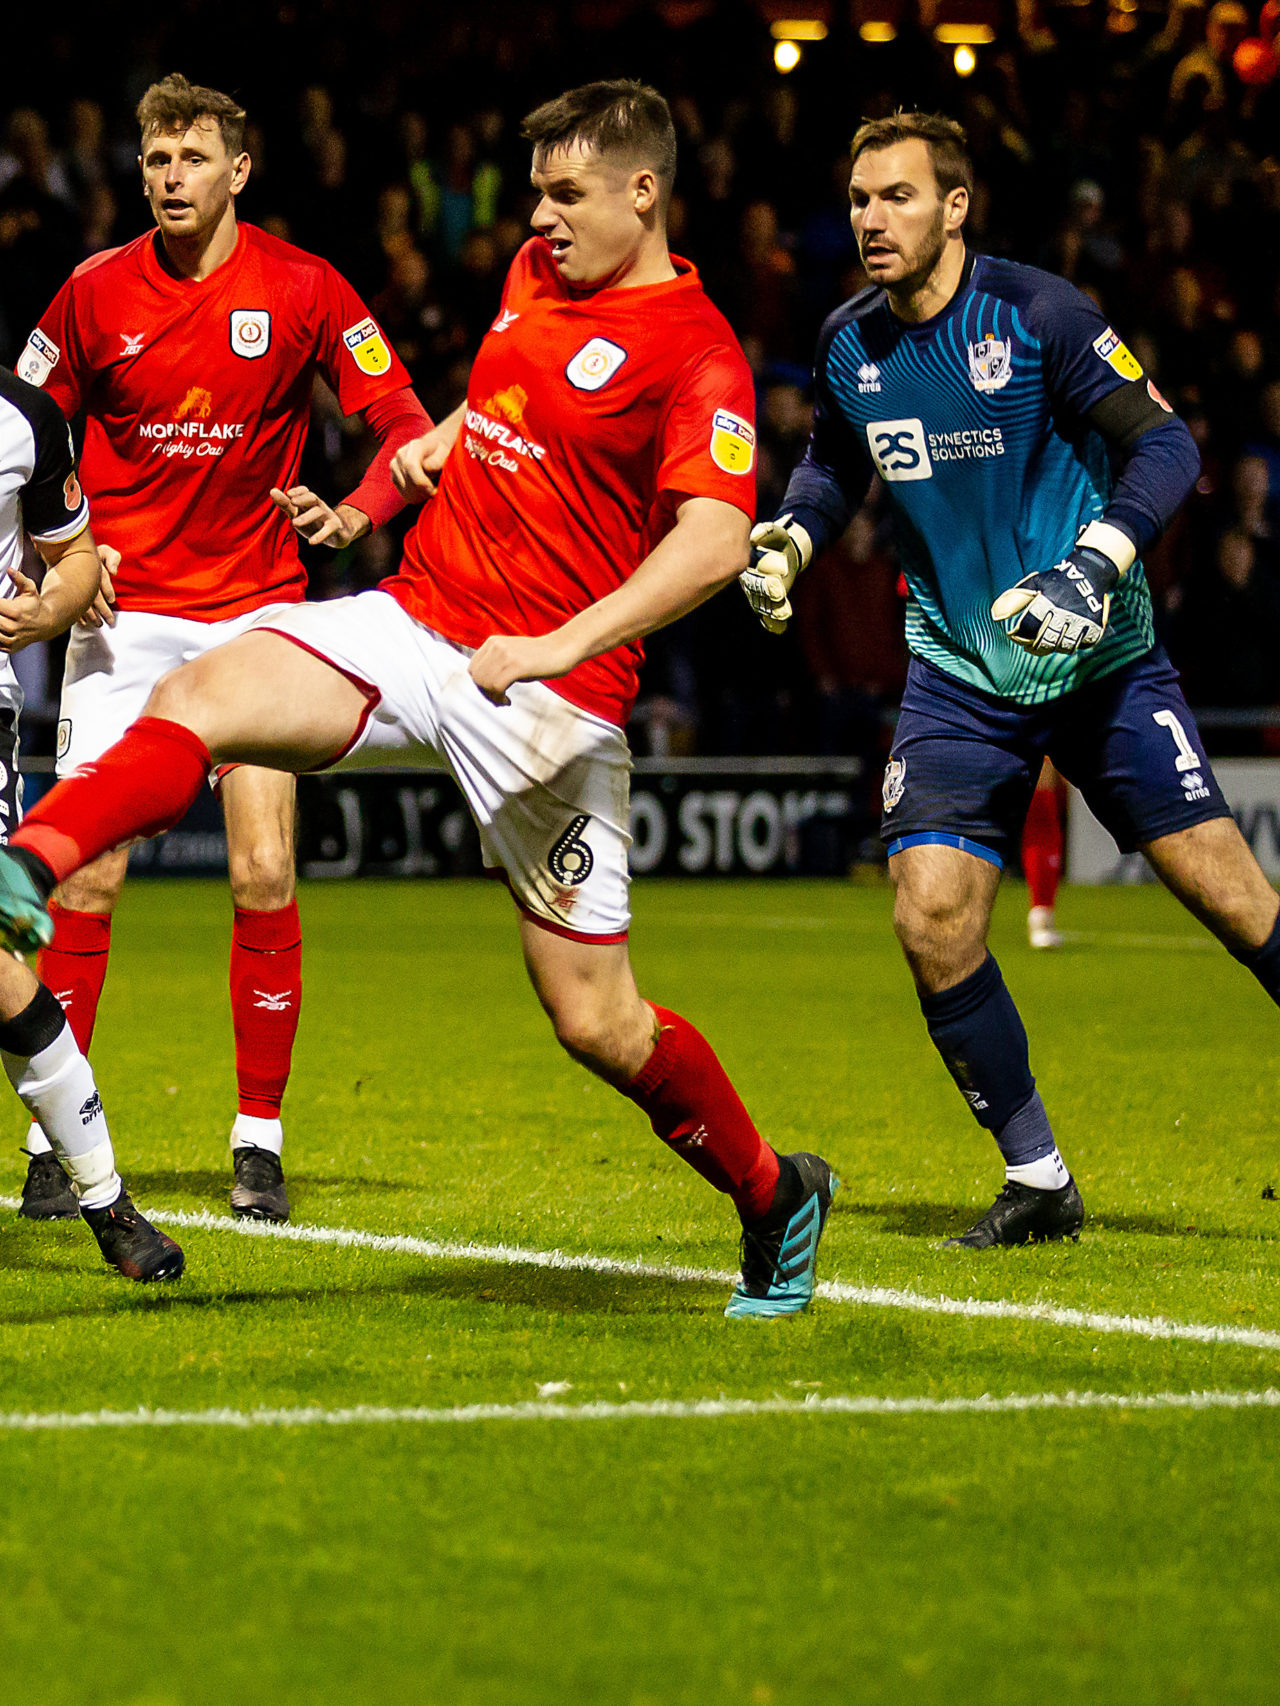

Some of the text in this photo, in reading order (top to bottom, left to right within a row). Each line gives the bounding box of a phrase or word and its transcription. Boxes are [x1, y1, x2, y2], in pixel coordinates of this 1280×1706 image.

[928, 428, 1002, 448] SYNECTICS
[931, 442, 1005, 461] SOLUTIONS
[1152, 709, 1201, 772] 1
[547, 814, 594, 886] 6
